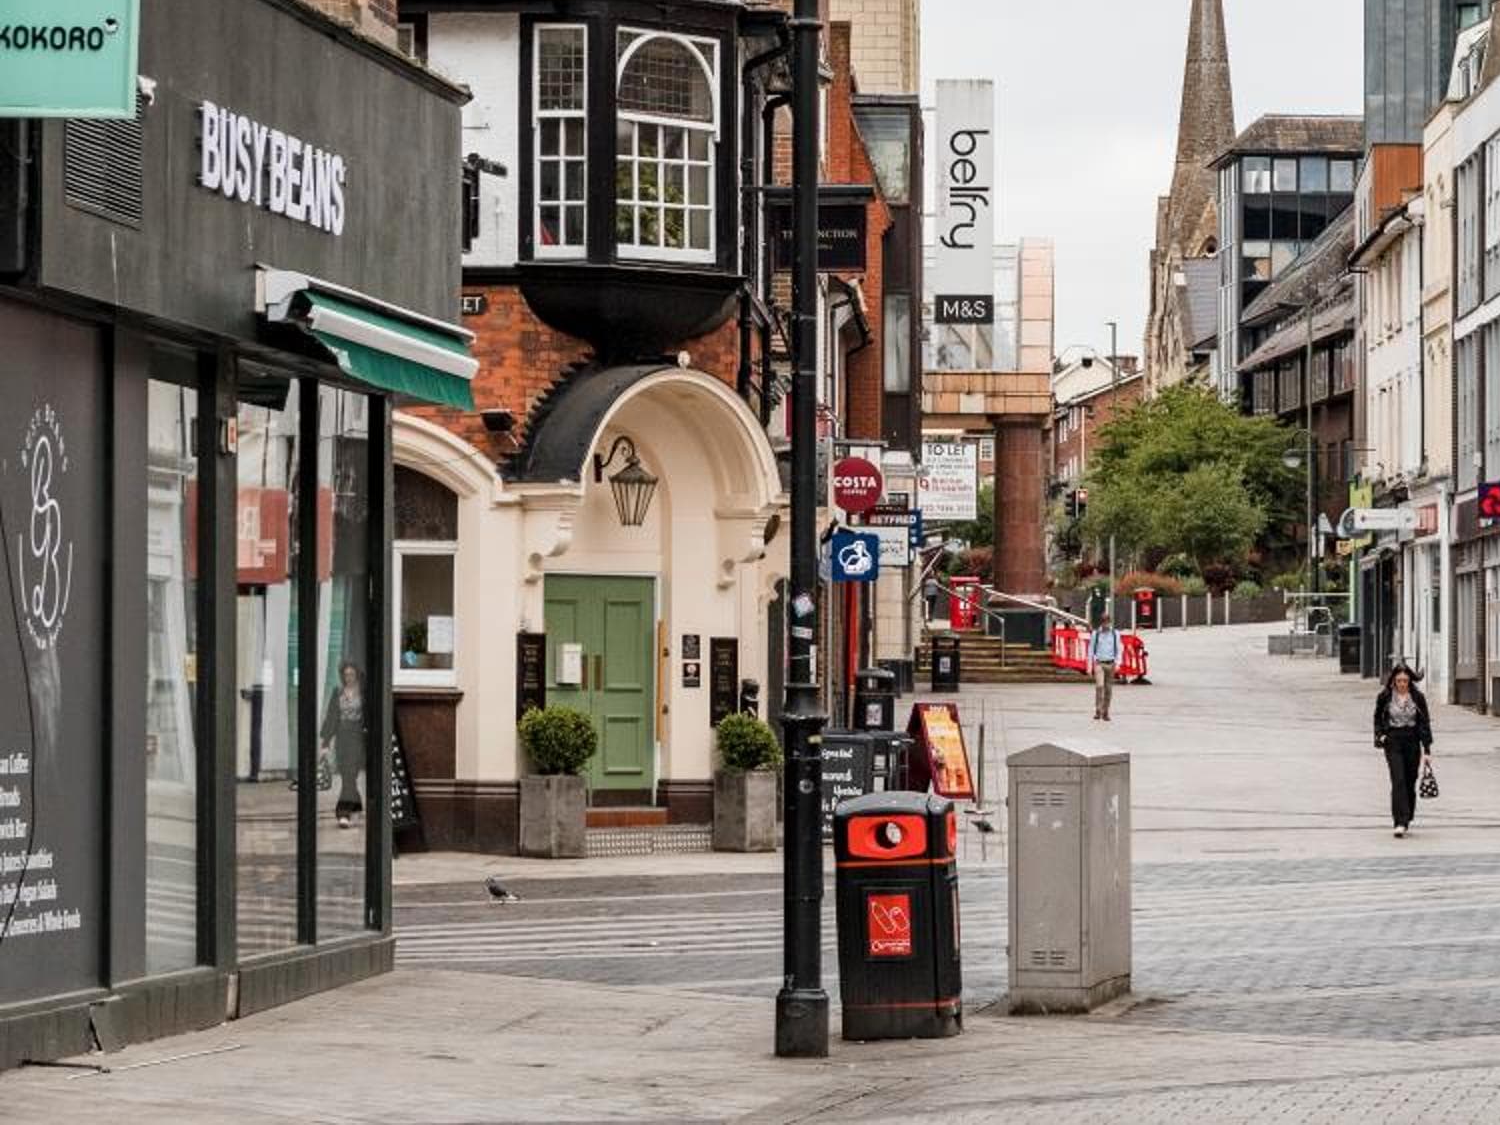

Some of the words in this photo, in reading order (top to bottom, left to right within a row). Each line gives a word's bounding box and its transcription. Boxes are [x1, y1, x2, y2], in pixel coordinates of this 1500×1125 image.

[0, 24, 104, 51] KOKORO
[202, 100, 268, 206] BUSY
[269, 129, 346, 236] BEANS
[939, 130, 989, 249] belfry
[943, 299, 987, 318] M&S
[928, 444, 944, 456] TO
[947, 444, 967, 456] LET
[834, 477, 877, 488] COSTA
